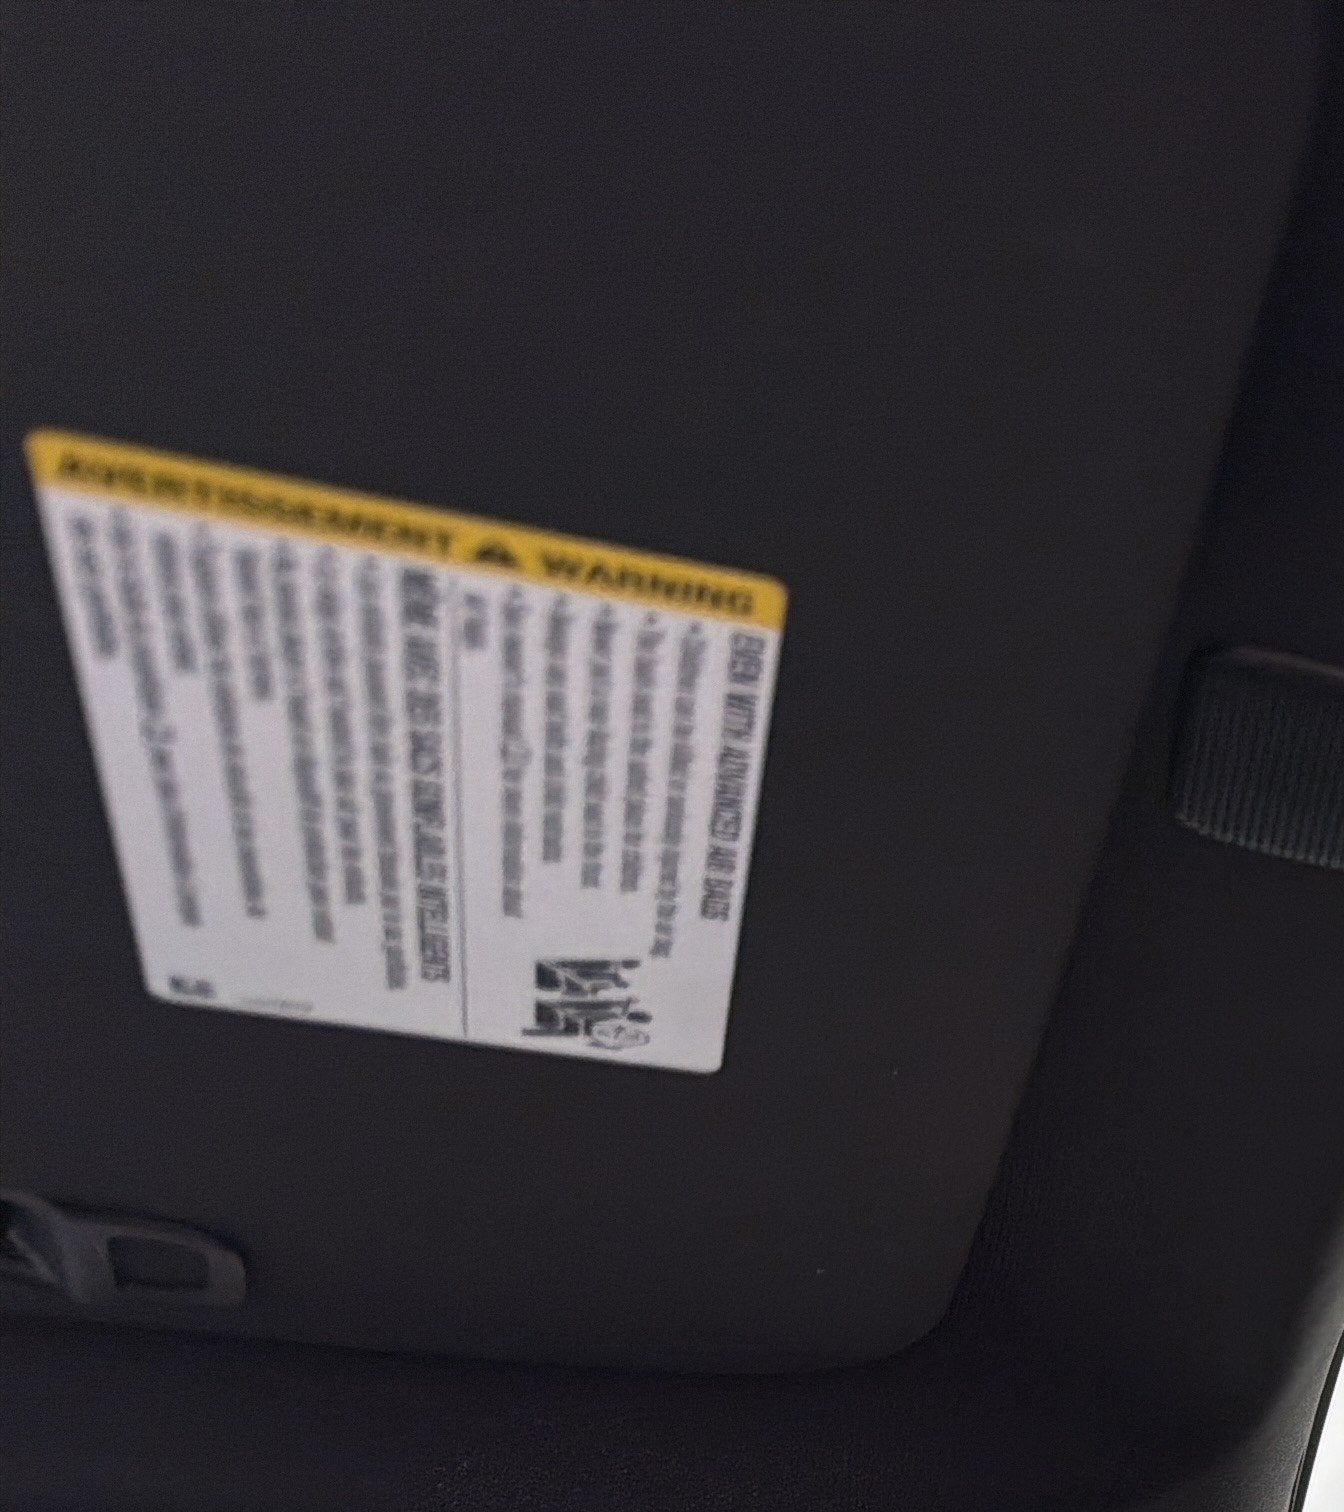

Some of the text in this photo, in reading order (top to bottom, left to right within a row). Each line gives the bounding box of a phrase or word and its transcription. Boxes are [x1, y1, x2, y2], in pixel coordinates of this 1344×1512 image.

[541, 549, 754, 616] WARNING
[701, 631, 765, 922] EVEN WITH ADVANCED AIR BAGS
